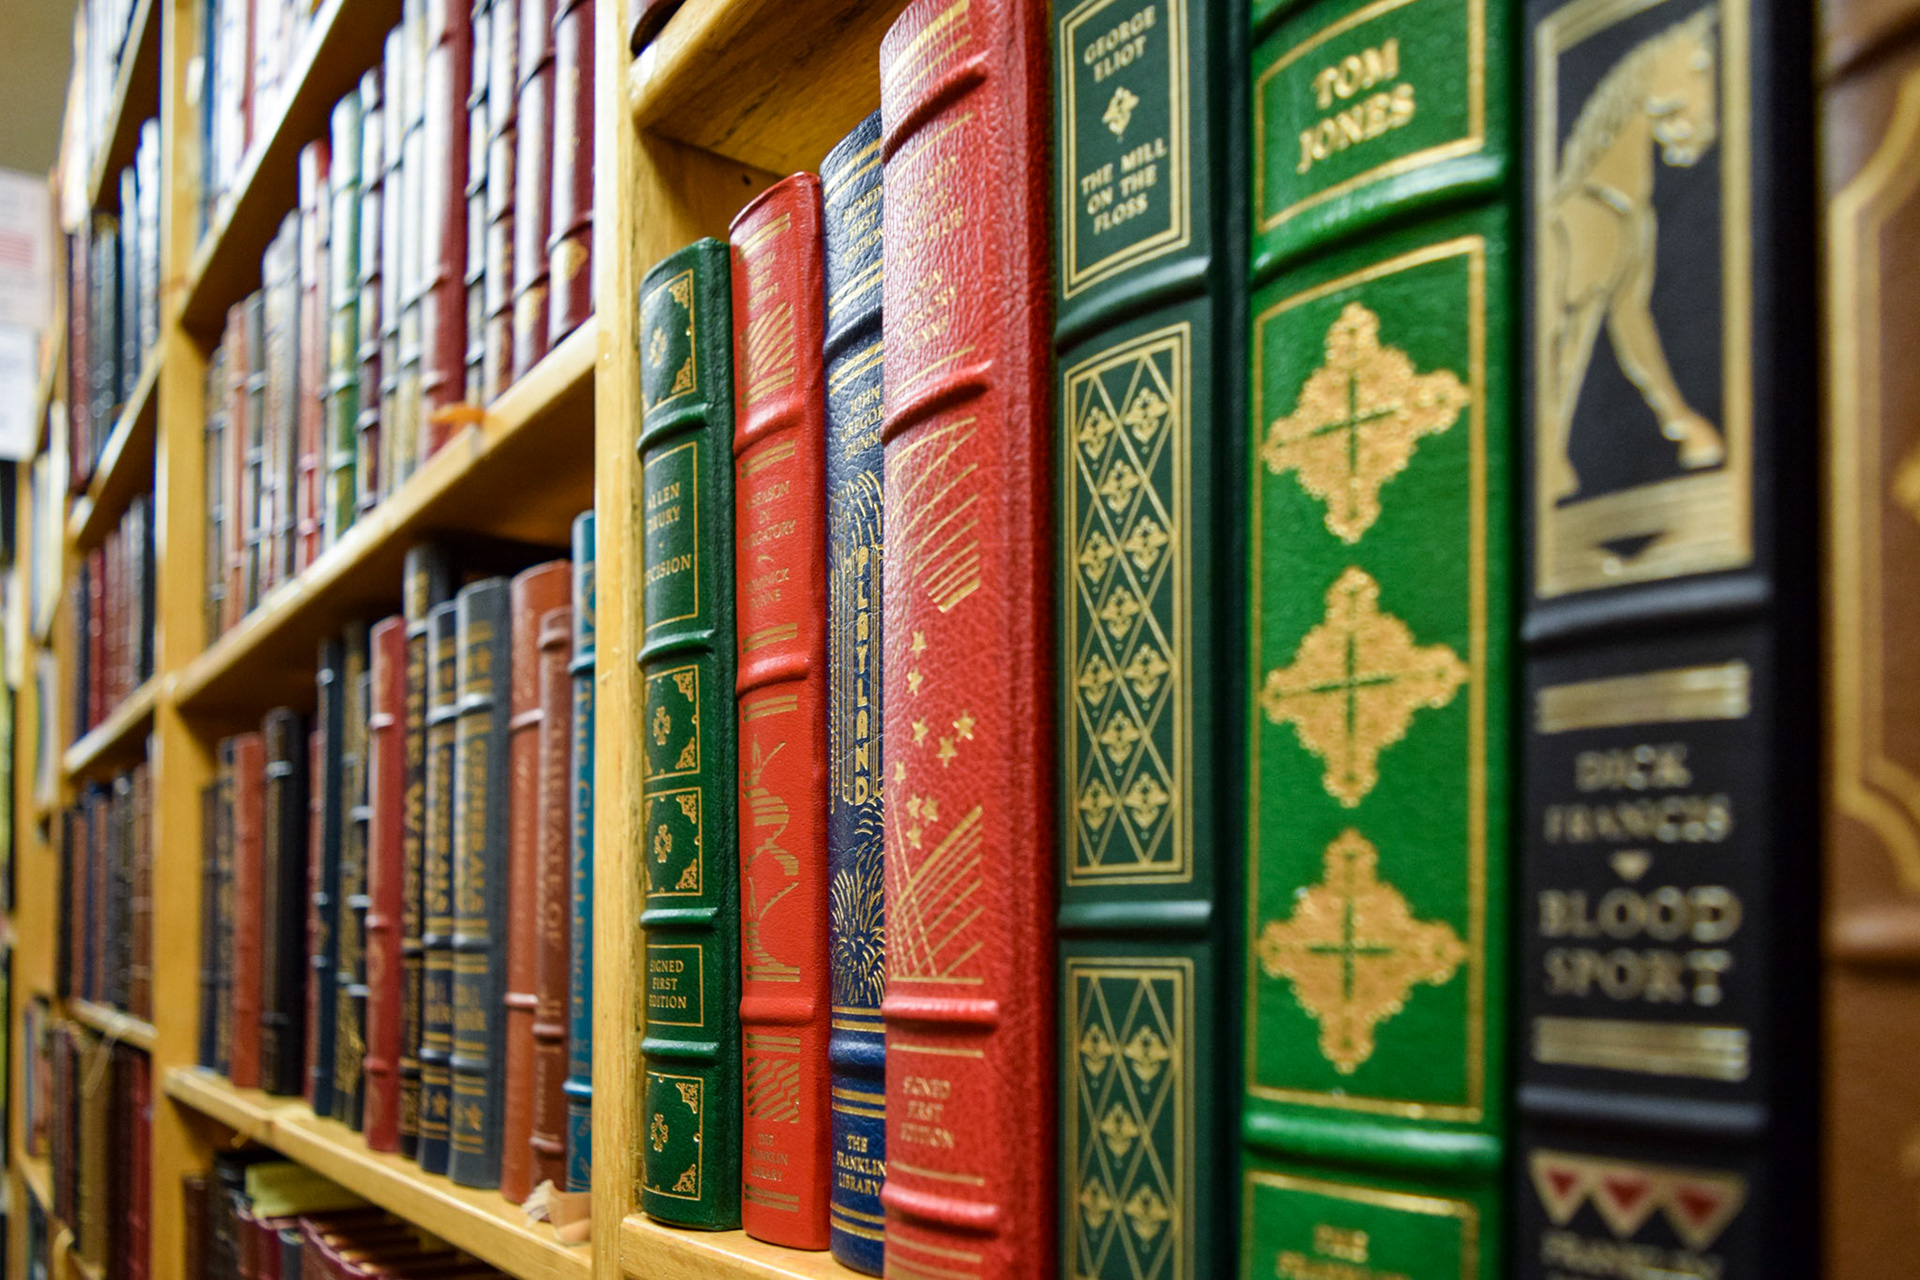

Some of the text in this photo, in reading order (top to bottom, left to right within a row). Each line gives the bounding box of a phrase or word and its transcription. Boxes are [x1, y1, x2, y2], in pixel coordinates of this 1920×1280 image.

[1083, 5, 1156, 66] GEORGE
[1093, 34, 1146, 83] ELIOT
[1313, 39, 1400, 111] TOM
[1295, 82, 1416, 175] JONES
[1080, 137, 1168, 196] THE MILL
[843, 185, 883, 226] SIGNED
[1087, 167, 1158, 216] ON THE
[849, 210, 878, 241] FIRST
[1093, 193, 1148, 236] FLOSS
[849, 385, 881, 416] JOHN
[840, 406, 884, 443] GREGOR
[844, 433, 882, 462] DUNN
[646, 482, 680, 512] ALLEN
[751, 480, 790, 506] SEASON
[646, 506, 680, 536] DRURY
[854, 544, 870, 807] PLAYLAND
[1576, 743, 1692, 791] DICK
[1539, 885, 1742, 942] BLOOD
[649, 960, 684, 973] SIGNED
[652, 977, 678, 990] FIRST
[1542, 949, 1733, 1007] SPORT
[648, 994, 687, 1009] EDITION
[847, 1134, 868, 1152] THE
[836, 1151, 887, 1177] FRANKLIN
[838, 1172, 882, 1197] LIBRARY
